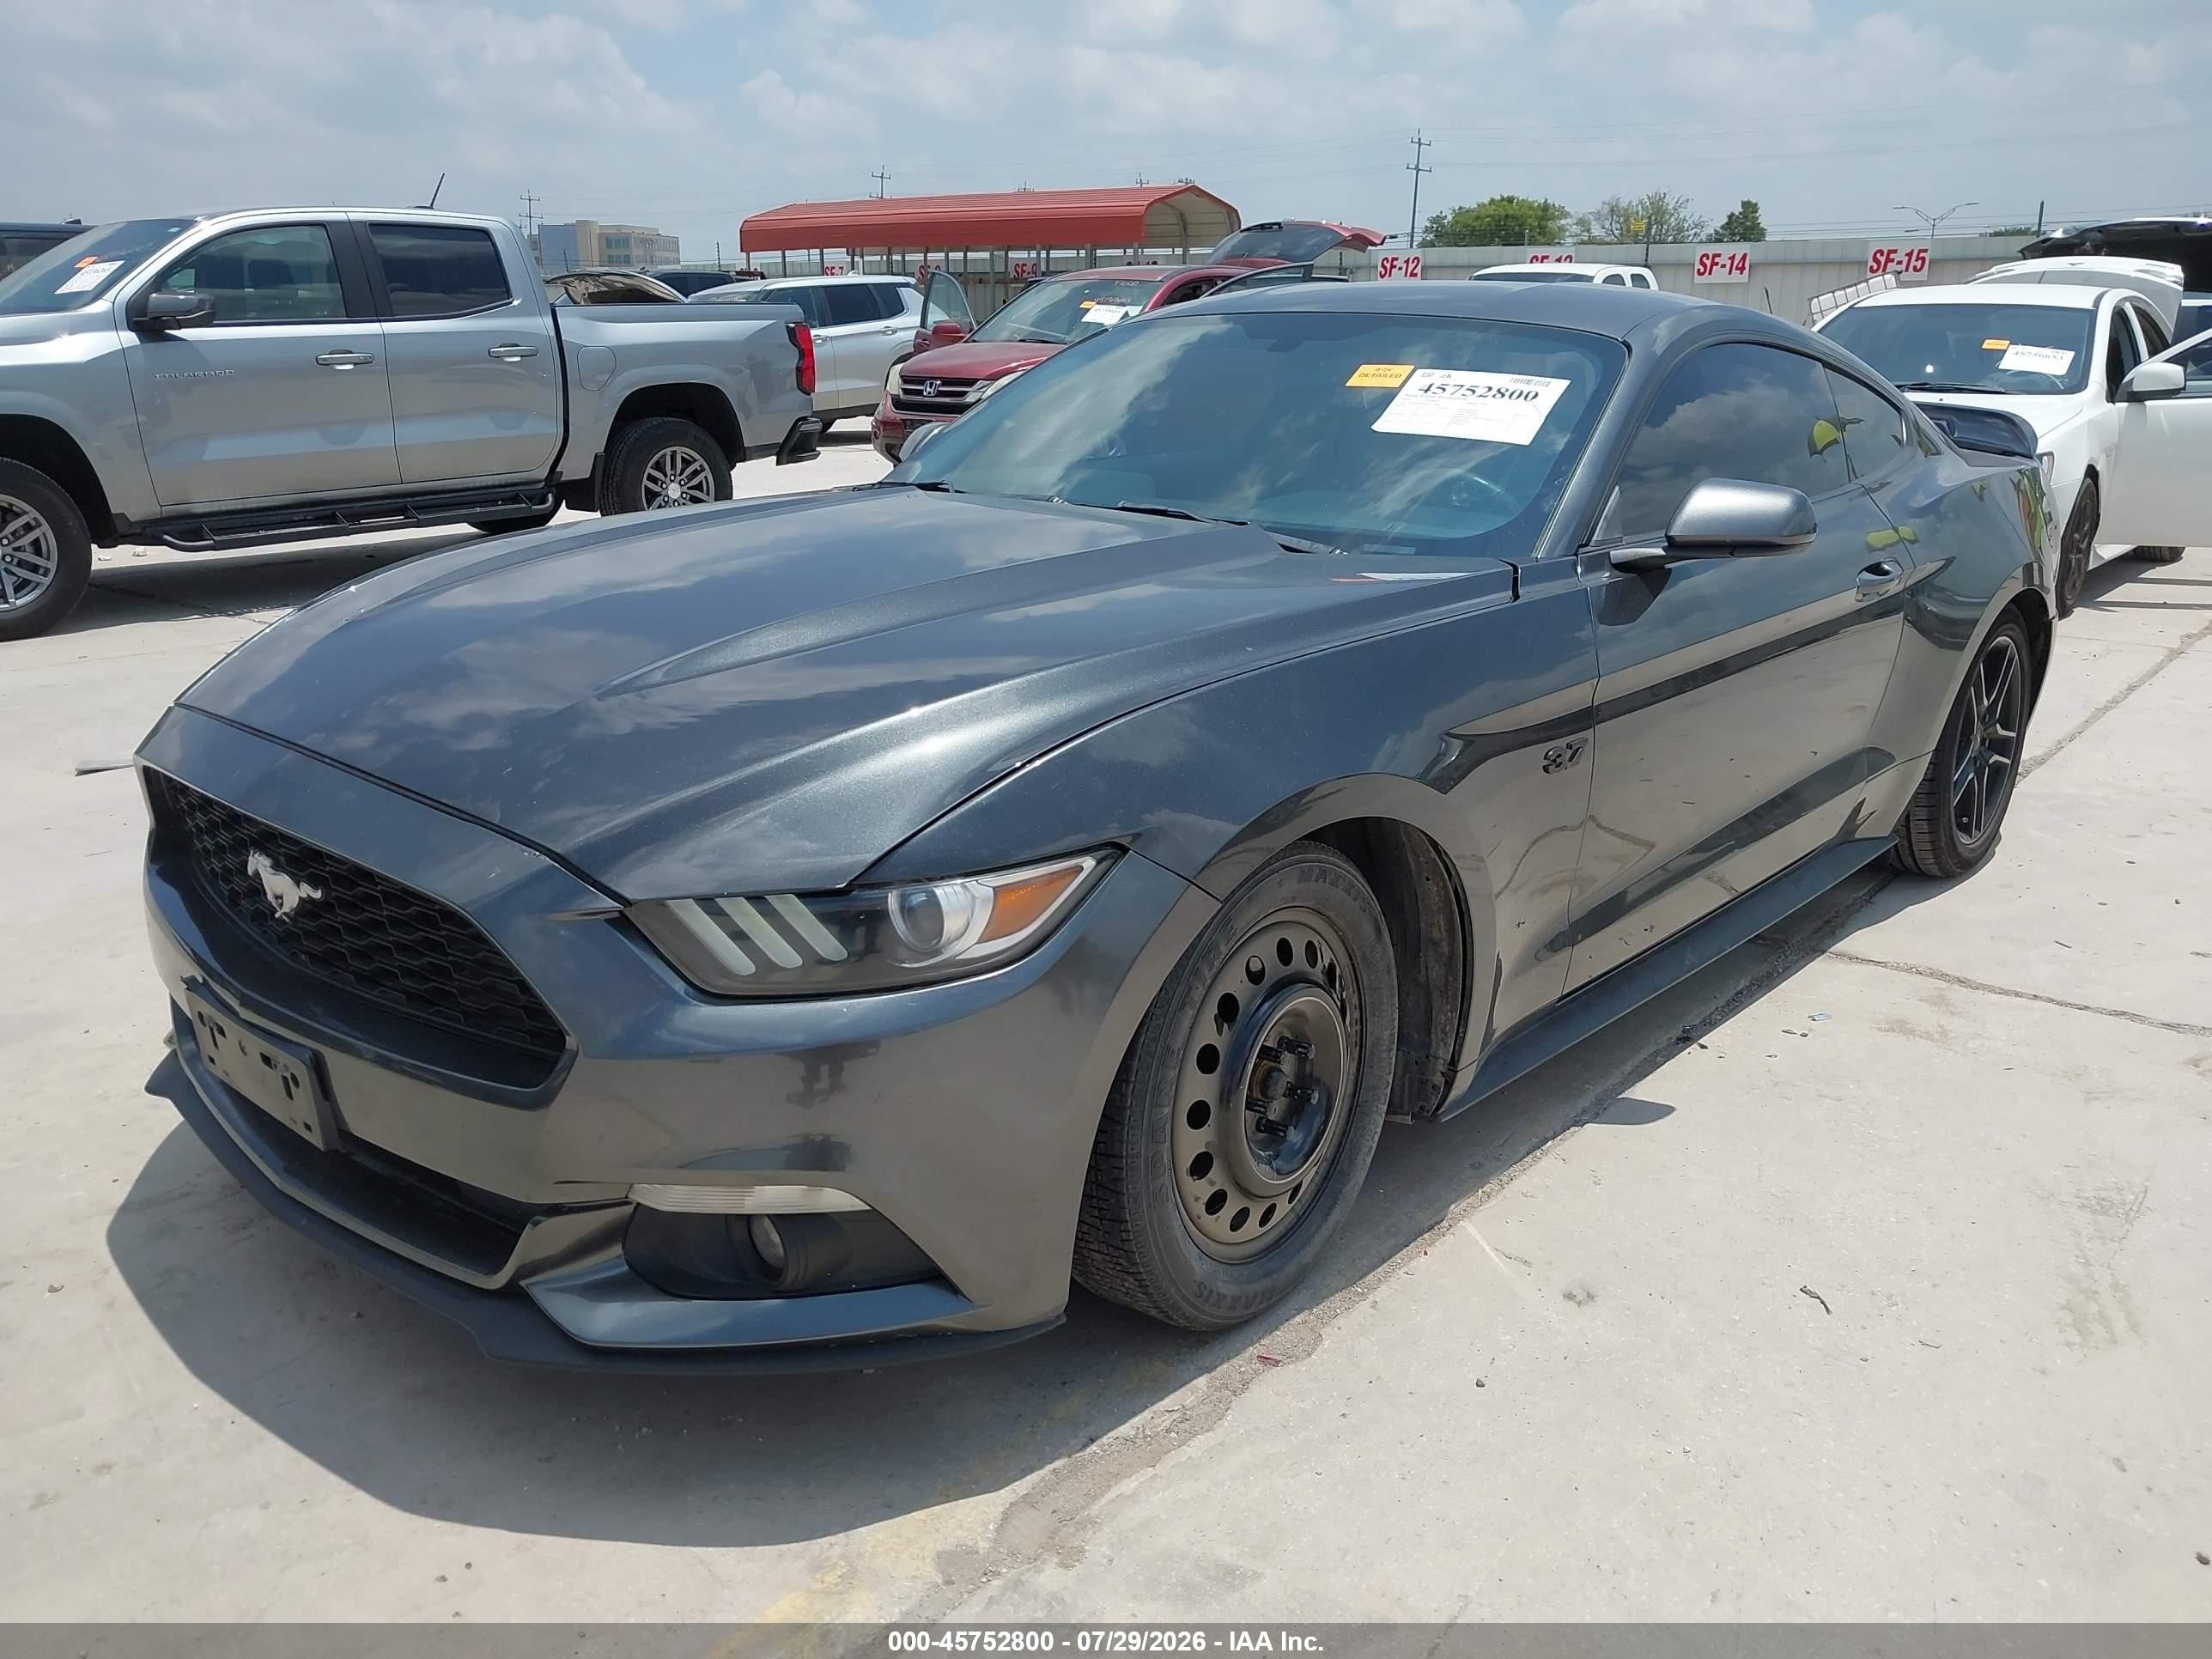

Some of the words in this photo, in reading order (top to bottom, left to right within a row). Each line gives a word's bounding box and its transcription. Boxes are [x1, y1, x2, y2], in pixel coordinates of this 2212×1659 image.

[1013, 263, 1037, 279] SF-9
[1379, 256, 1420, 279] SF-12
[1696, 252, 1748, 276] SF-14
[1869, 248, 1929, 275] SF-15
[1418, 382, 1540, 402] 45752800
[1297, 866, 1371, 914] MAXXIS
[1149, 1044, 1181, 1207] SPARE
